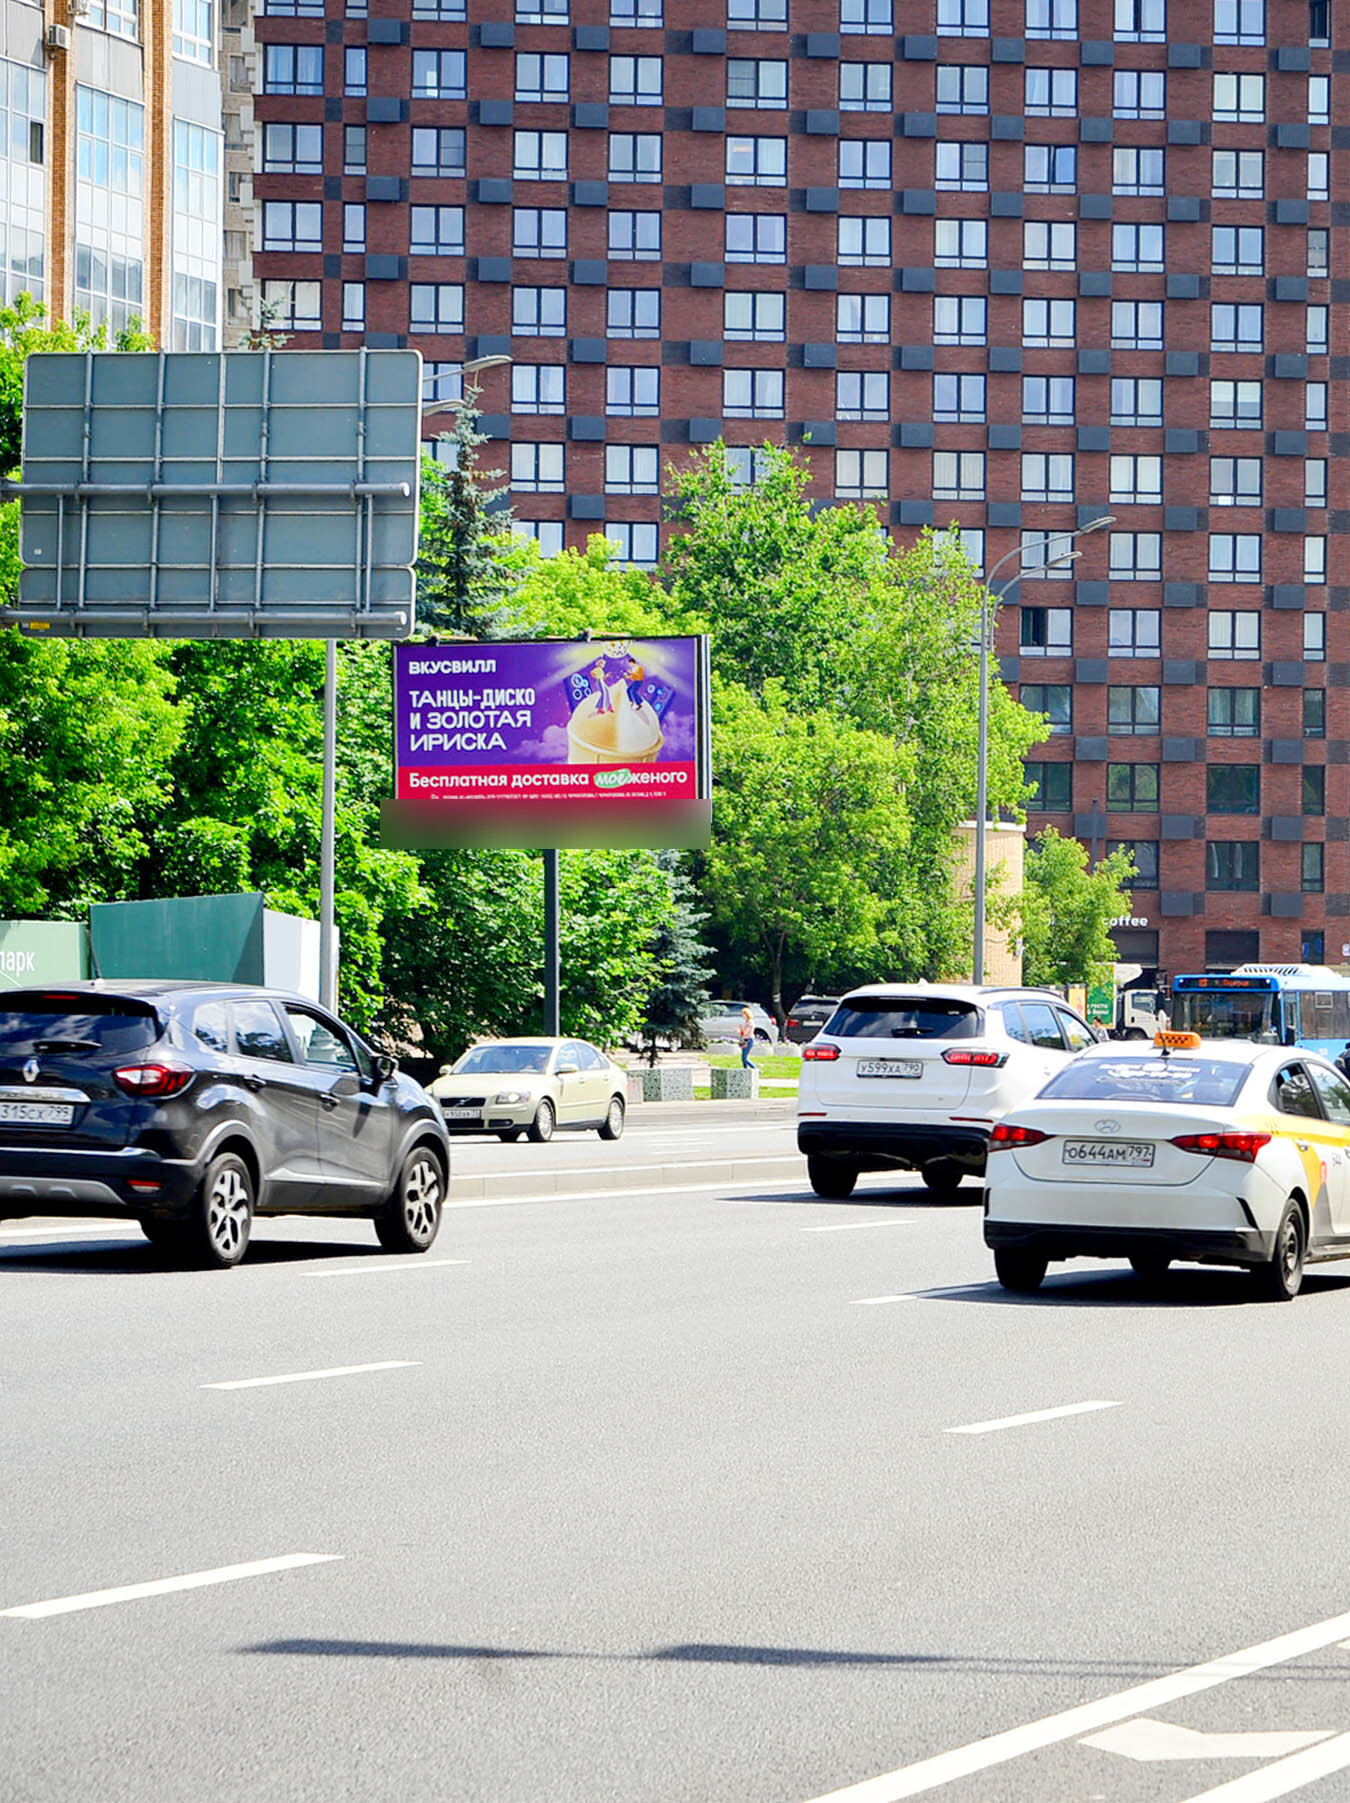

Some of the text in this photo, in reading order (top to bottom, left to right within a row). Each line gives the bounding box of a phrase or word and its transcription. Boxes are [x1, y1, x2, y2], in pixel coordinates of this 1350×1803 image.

[408, 659, 496, 675] ВКУСВИЛЛ
[409, 687, 536, 709] ТАНЦЫ-ДИСКО
[410, 710, 532, 729] И ЗОЛОТАЯ
[409, 733, 507, 752] ИРИСКА
[409, 772, 507, 788] Бесплатная
[511, 772, 589, 788] доставка
[1102, 915, 1148, 927] coffee
